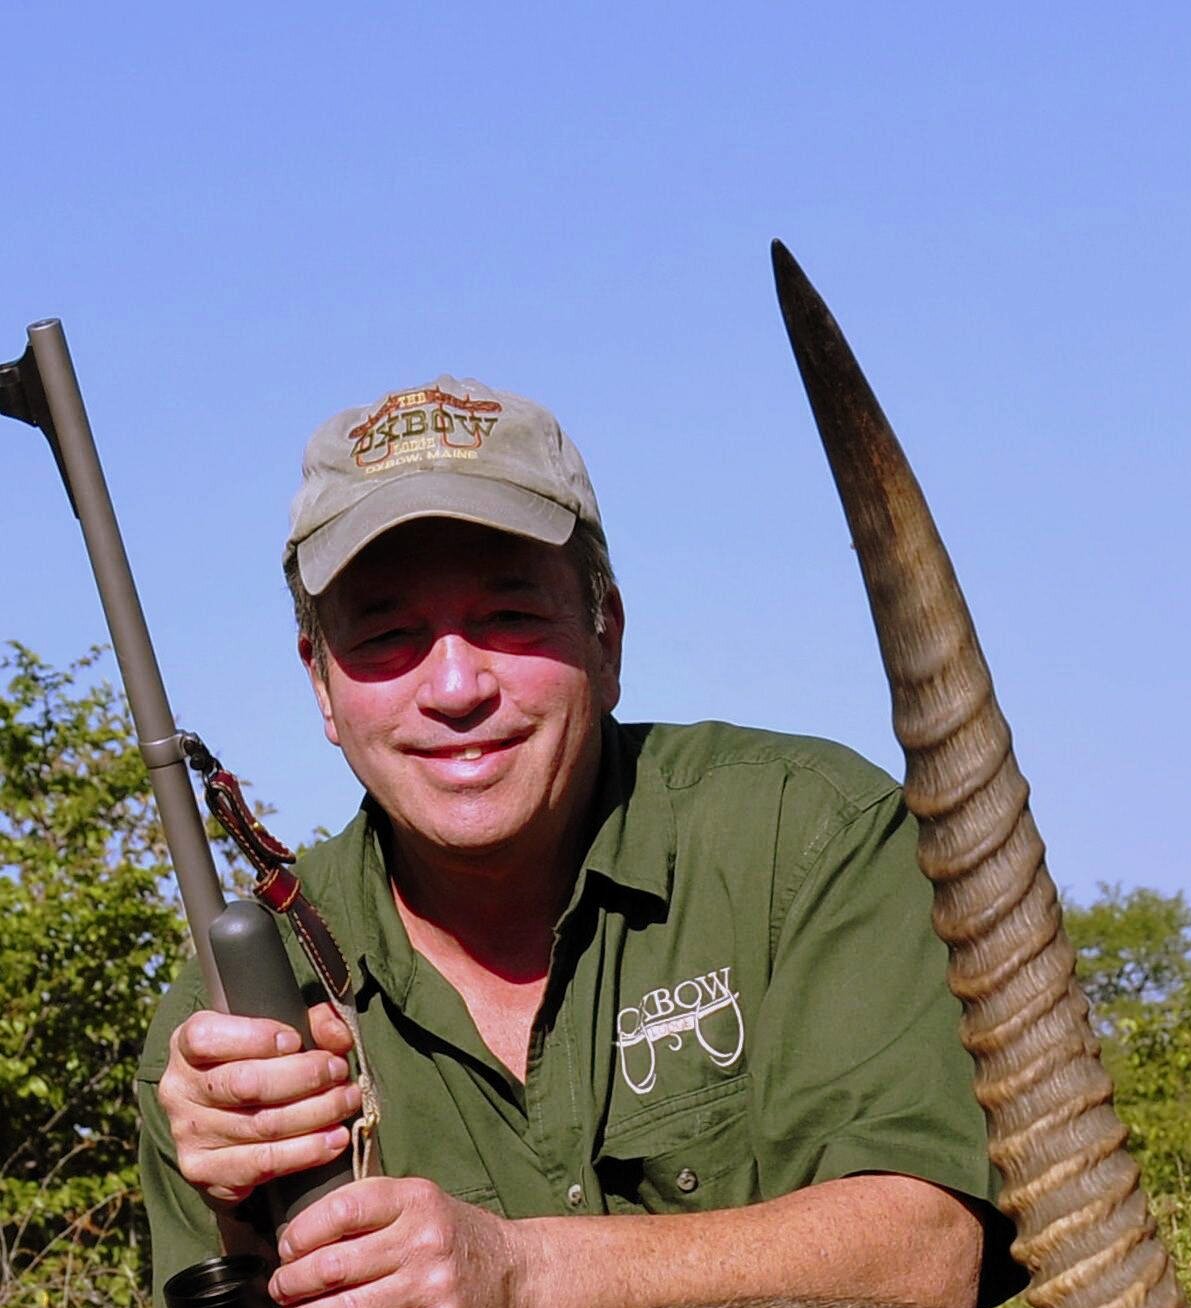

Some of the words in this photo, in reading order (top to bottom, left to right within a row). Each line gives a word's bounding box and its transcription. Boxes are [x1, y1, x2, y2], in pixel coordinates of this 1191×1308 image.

[399, 393, 425, 406] THE
[350, 409, 498, 457] OXBOW
[427, 449, 478, 459] MAINE
